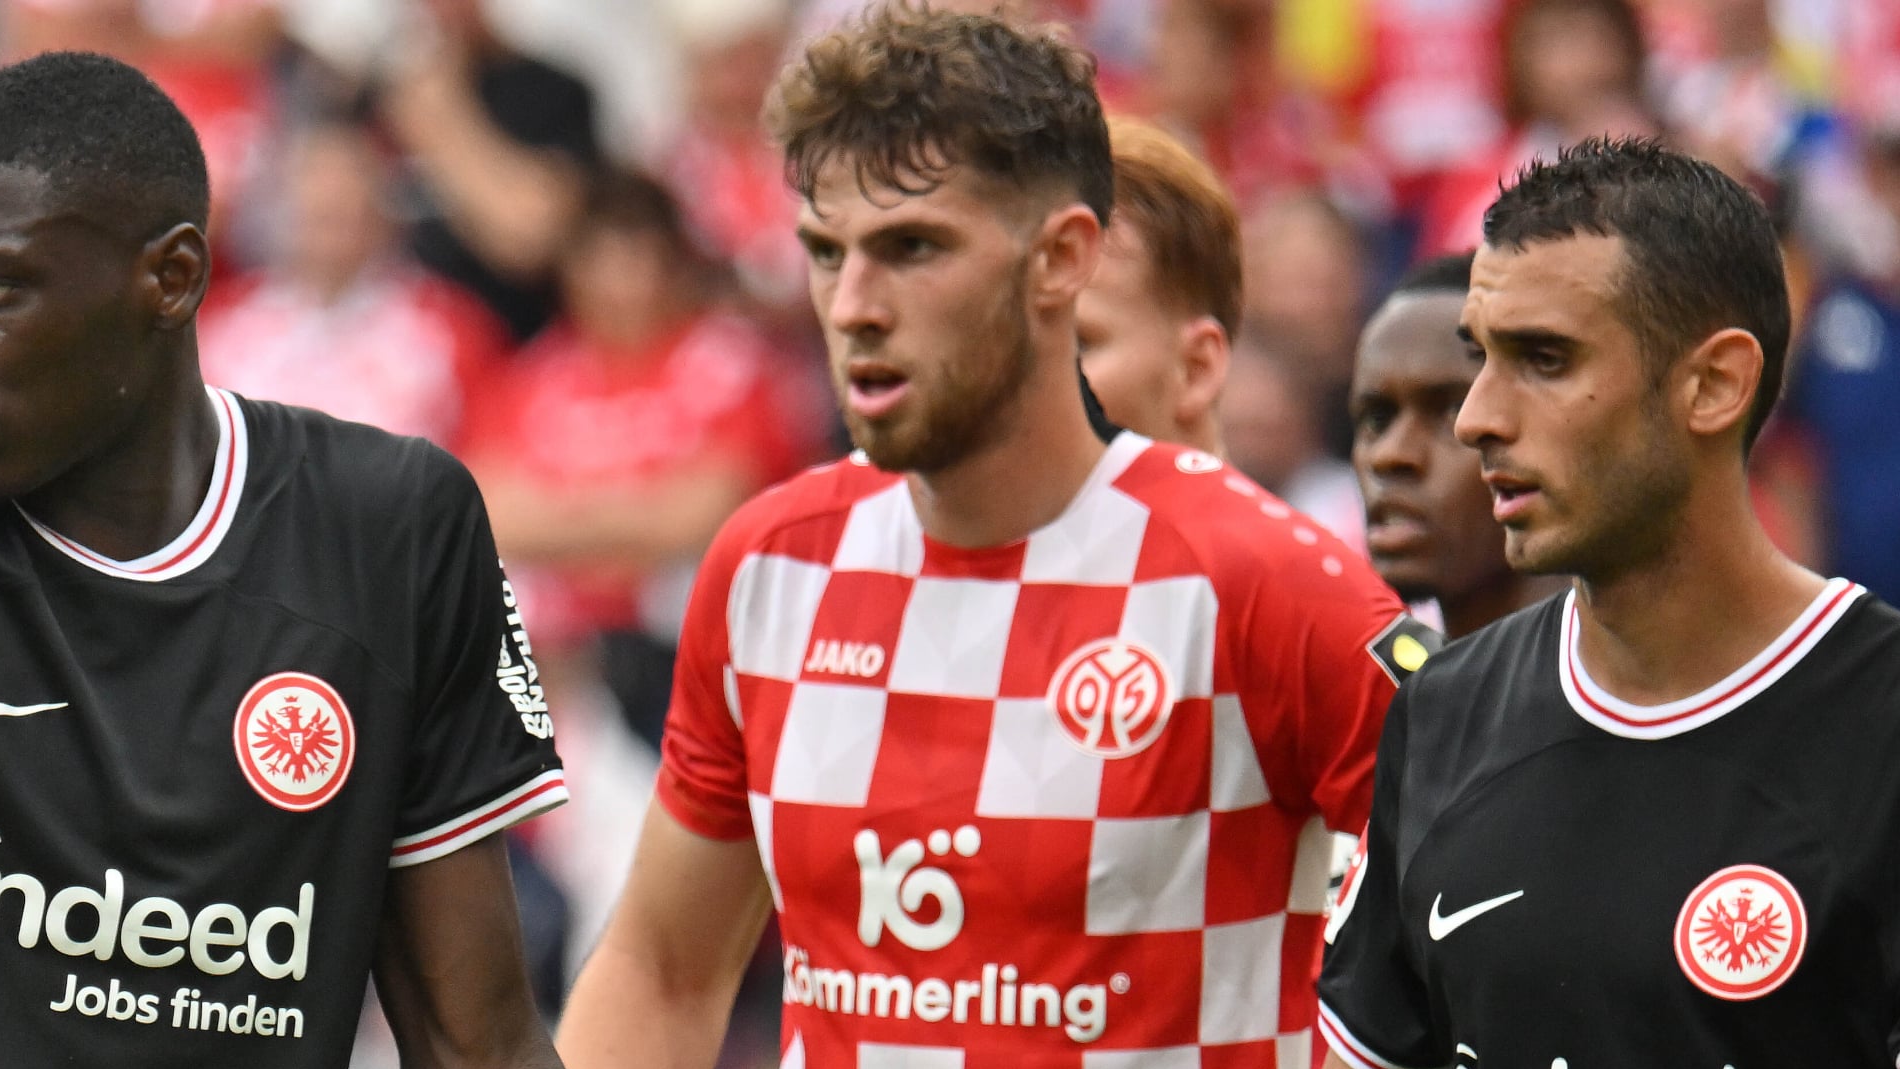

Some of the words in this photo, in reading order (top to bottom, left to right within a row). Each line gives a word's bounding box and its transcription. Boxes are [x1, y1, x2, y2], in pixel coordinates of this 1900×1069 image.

[804, 639, 886, 678] JAKO
[50, 974, 159, 1025] Jobs
[170, 987, 304, 1038] finden
